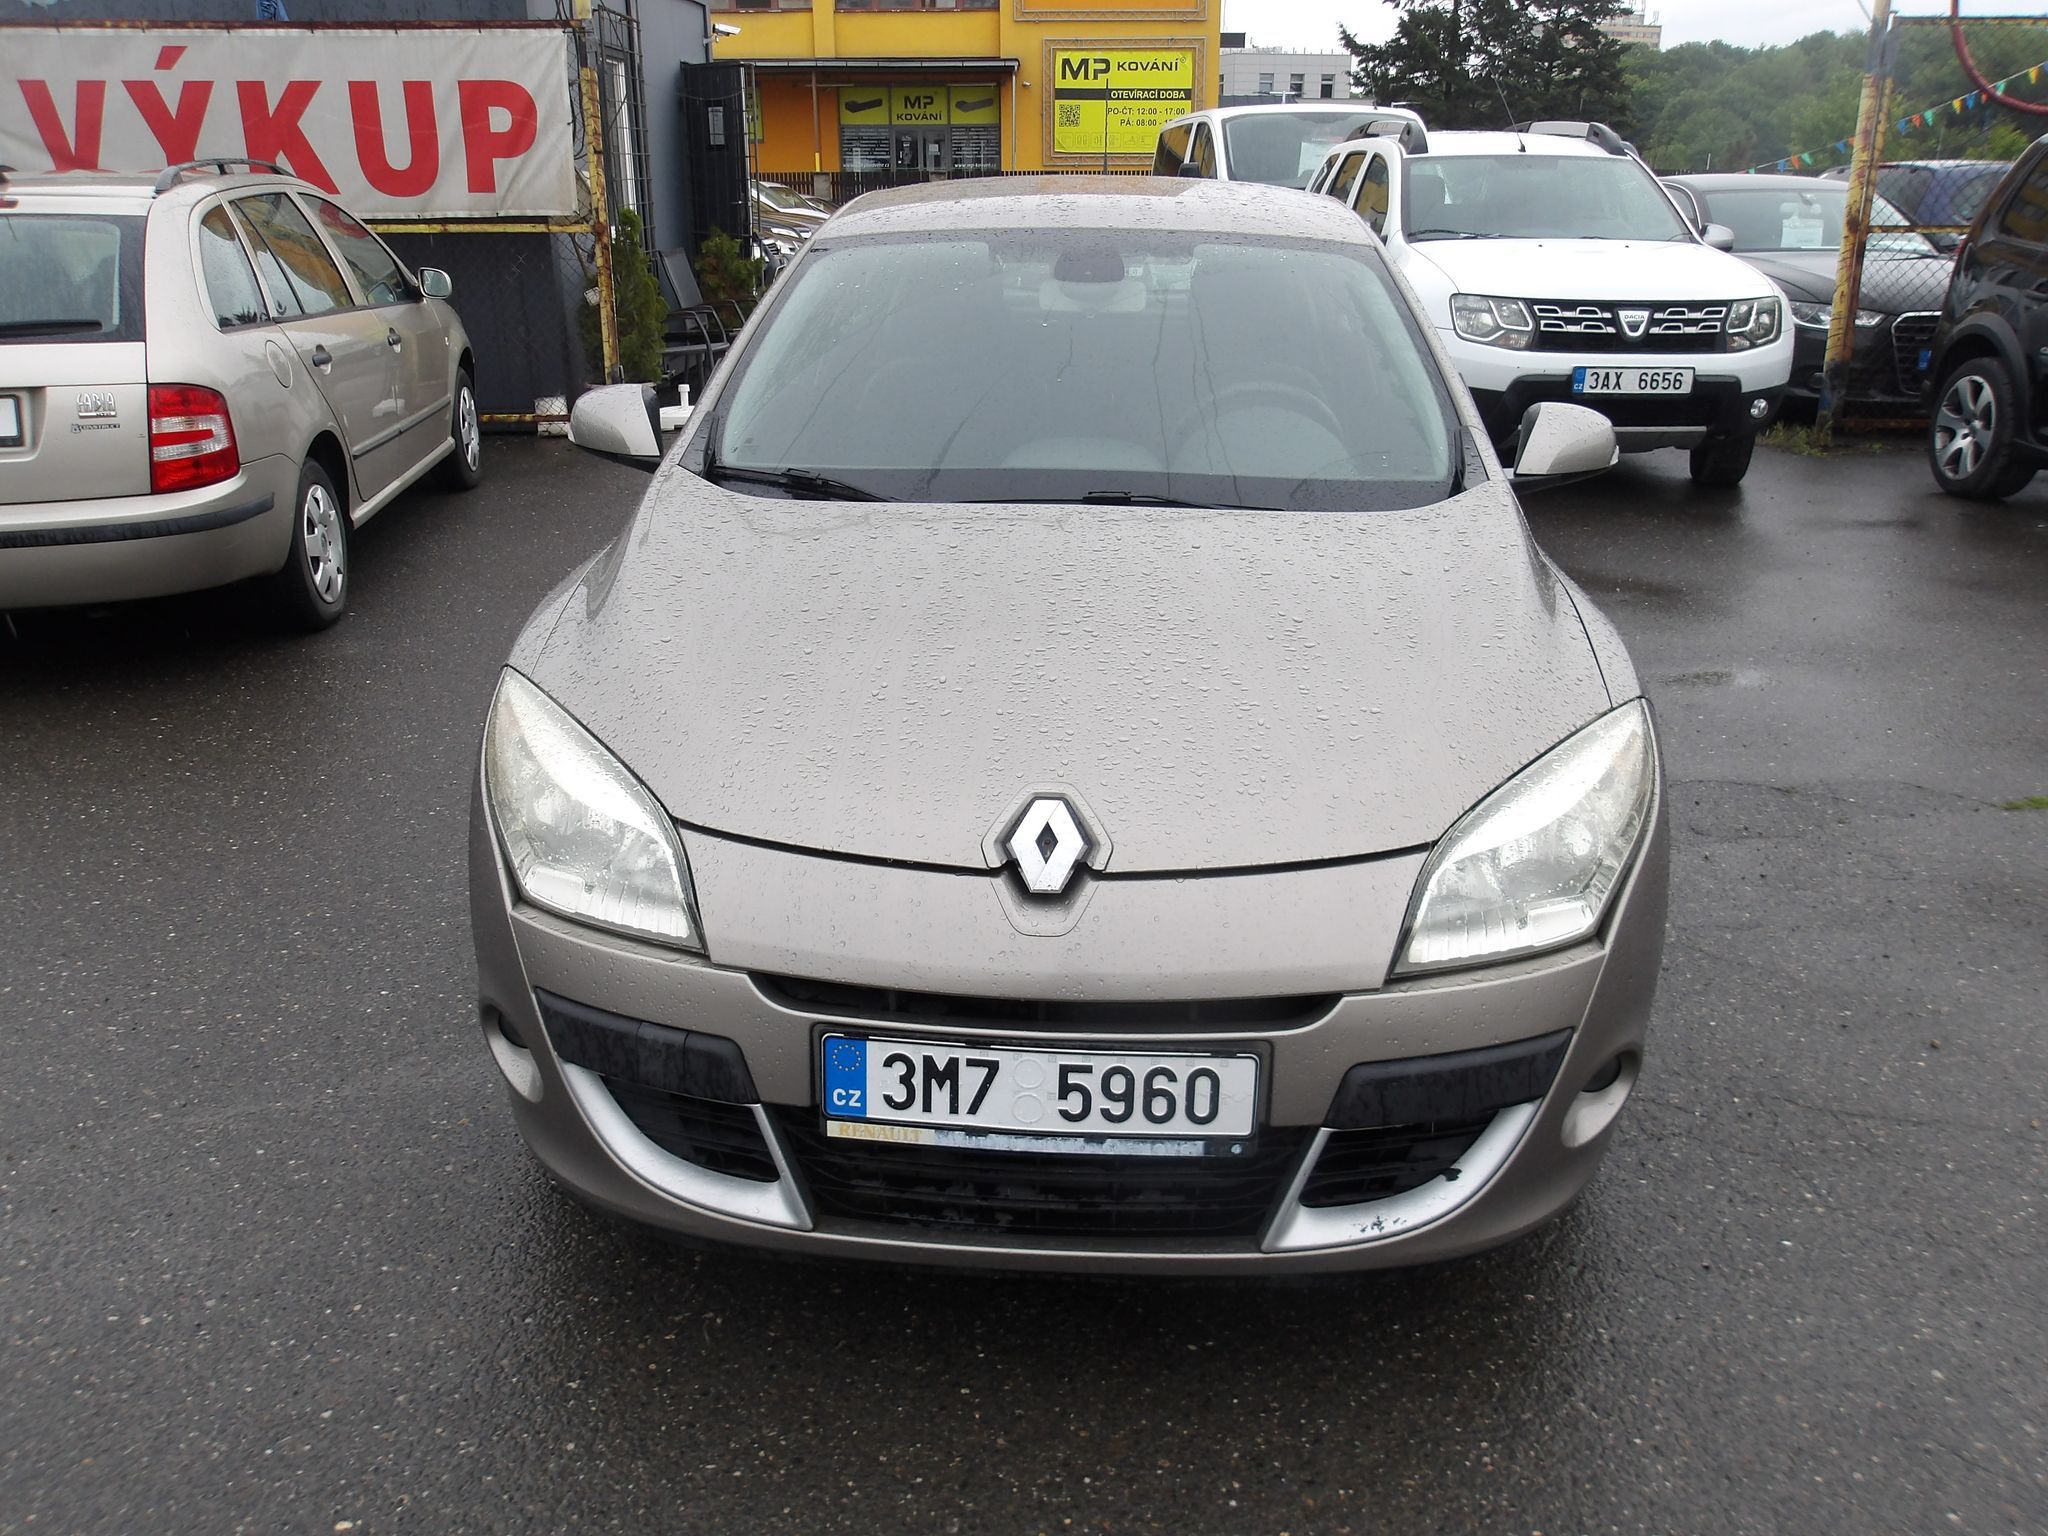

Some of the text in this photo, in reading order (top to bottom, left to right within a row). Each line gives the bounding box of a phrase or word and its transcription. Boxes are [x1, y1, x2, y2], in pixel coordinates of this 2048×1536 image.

[1061, 58, 1179, 80] MP KOVÁNÍ
[904, 95, 934, 109] MP
[1111, 89, 1186, 99] OTEVÍRACÍ DOBA
[896, 111, 942, 121] KOVÁNÍ
[1137, 107, 1157, 115] 12:00
[1165, 107, 1185, 115] 17:00
[17, 45, 538, 197] VÝKUP
[1120, 118, 1134, 126] PÁ:
[1589, 372, 1623, 390] 3AX
[1638, 372, 1684, 390] 6656
[832, 1052, 1221, 1126] CZ 3M7 5960
[839, 1122, 921, 1142] RENAULT
